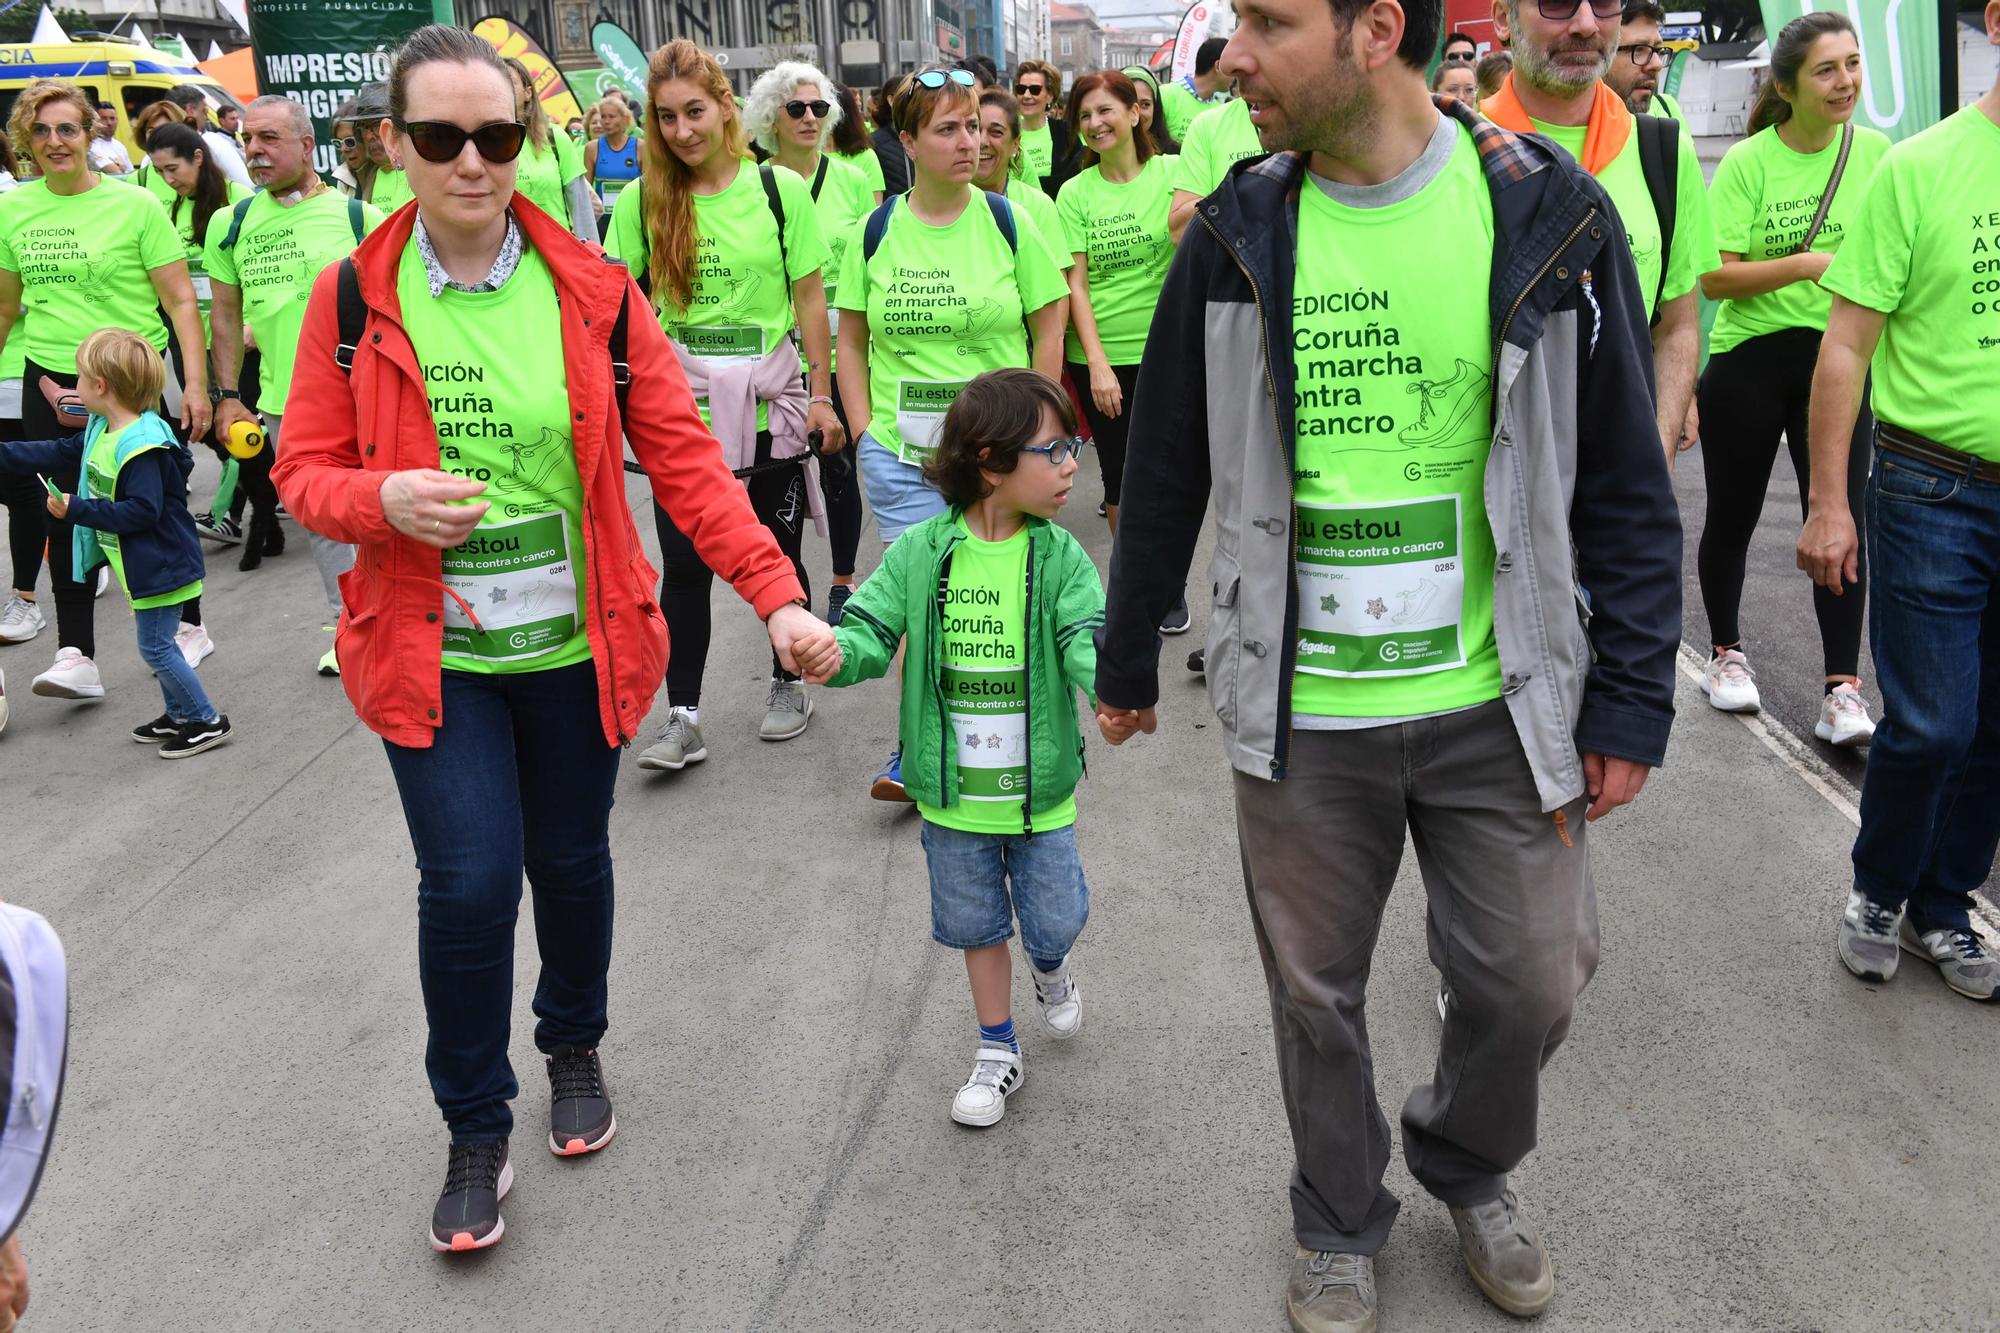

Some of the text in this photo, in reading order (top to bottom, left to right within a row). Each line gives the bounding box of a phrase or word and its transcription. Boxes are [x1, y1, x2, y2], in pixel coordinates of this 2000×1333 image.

[325, 2, 414, 11] PUBLICIDAD
[265, 45, 398, 84] IMPRESIÓ
[1765, 203, 1773, 213] X
[1765, 218, 1775, 231] A
[1972, 215, 1983, 230] X
[30, 227, 76, 238] EDICIÓN
[1091, 224, 1142, 241] A Coruña
[1764, 234, 1784, 245] en
[30, 240, 79, 251] Coruña
[246, 237, 253, 245] X
[253, 241, 297, 255] Coruña
[1091, 233, 1153, 253] en marcha
[1972, 237, 1988, 254] A
[34, 250, 88, 261] marcha
[243, 249, 305, 267] en marcha
[1093, 249, 1131, 263] contra
[244, 265, 280, 277] contra
[1103, 257, 1145, 271] cancro
[31, 274, 77, 286] cancro
[252, 273, 294, 287] cancro
[892, 267, 950, 280] X EDICIÓN
[887, 282, 955, 295] A Coruña
[885, 295, 967, 308] en marcha
[1292, 287, 1390, 317] EDICIÓN
[1971, 301, 1986, 315] o
[883, 310, 933, 322] contra
[884, 324, 952, 336] o cancro
[1293, 321, 1401, 352] Coruña
[698, 332, 735, 345] estou
[1308, 351, 1423, 380] marcha
[906, 386, 960, 400] Eu esto
[1296, 414, 1395, 437] cancro
[1322, 517, 1401, 541] estou
[1304, 546, 1345, 558] marcha
[1347, 547, 1390, 558] contra
[1391, 546, 1400, 555] o
[1403, 540, 1445, 555] cancro
[476, 558, 512, 569] contra
[513, 556, 520, 565] o
[522, 548, 556, 564] cancro
[549, 564, 567, 575] 0284
[1434, 561, 1456, 573] 0285
[945, 585, 1000, 606] DICIÓN
[941, 614, 1004, 635] Coruña
[950, 639, 1016, 659] marcha
[958, 678, 1016, 695] estou
[976, 699, 1008, 709] contra
